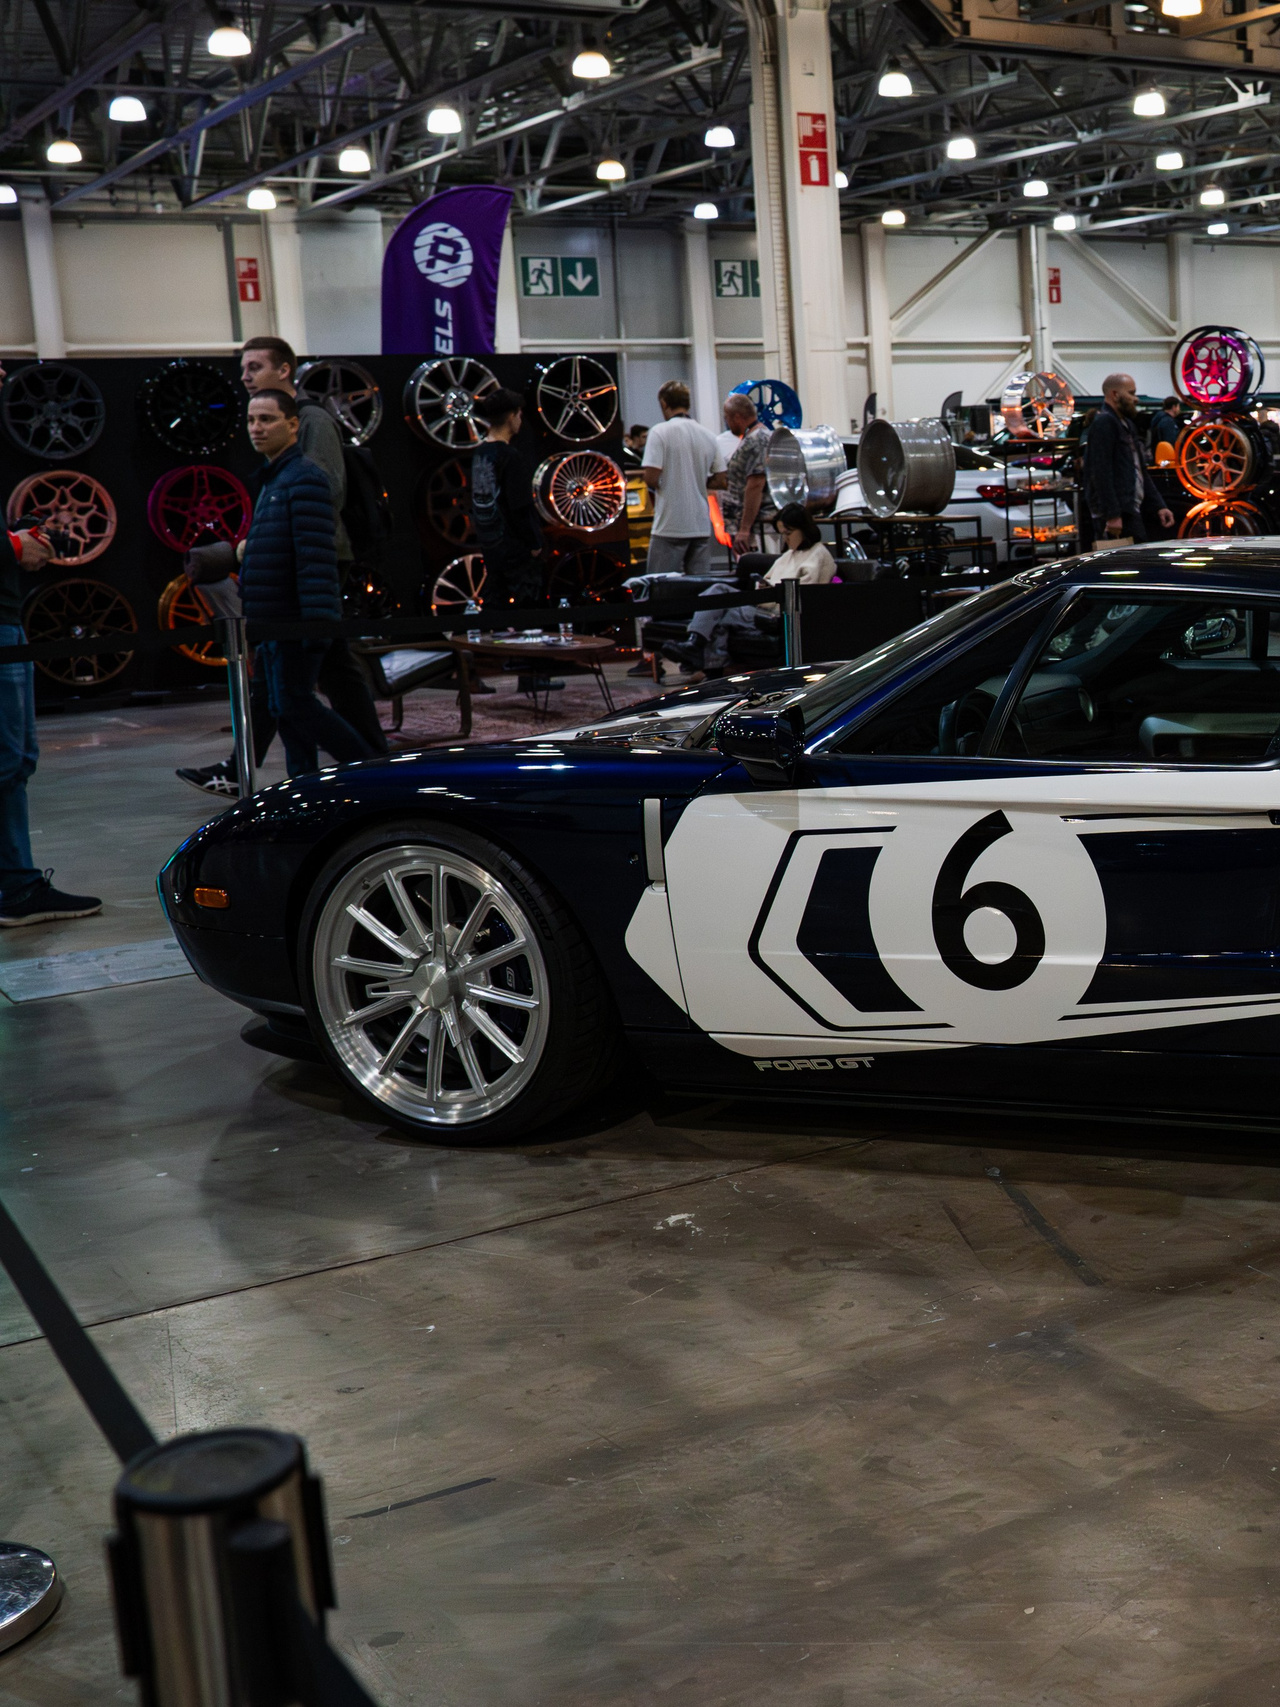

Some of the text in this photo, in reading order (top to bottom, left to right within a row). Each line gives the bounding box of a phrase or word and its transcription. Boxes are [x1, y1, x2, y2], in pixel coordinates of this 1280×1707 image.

[434, 297, 454, 355] ELS
[932, 809, 1046, 991] 6
[753, 1056, 875, 1072] FORD GT
